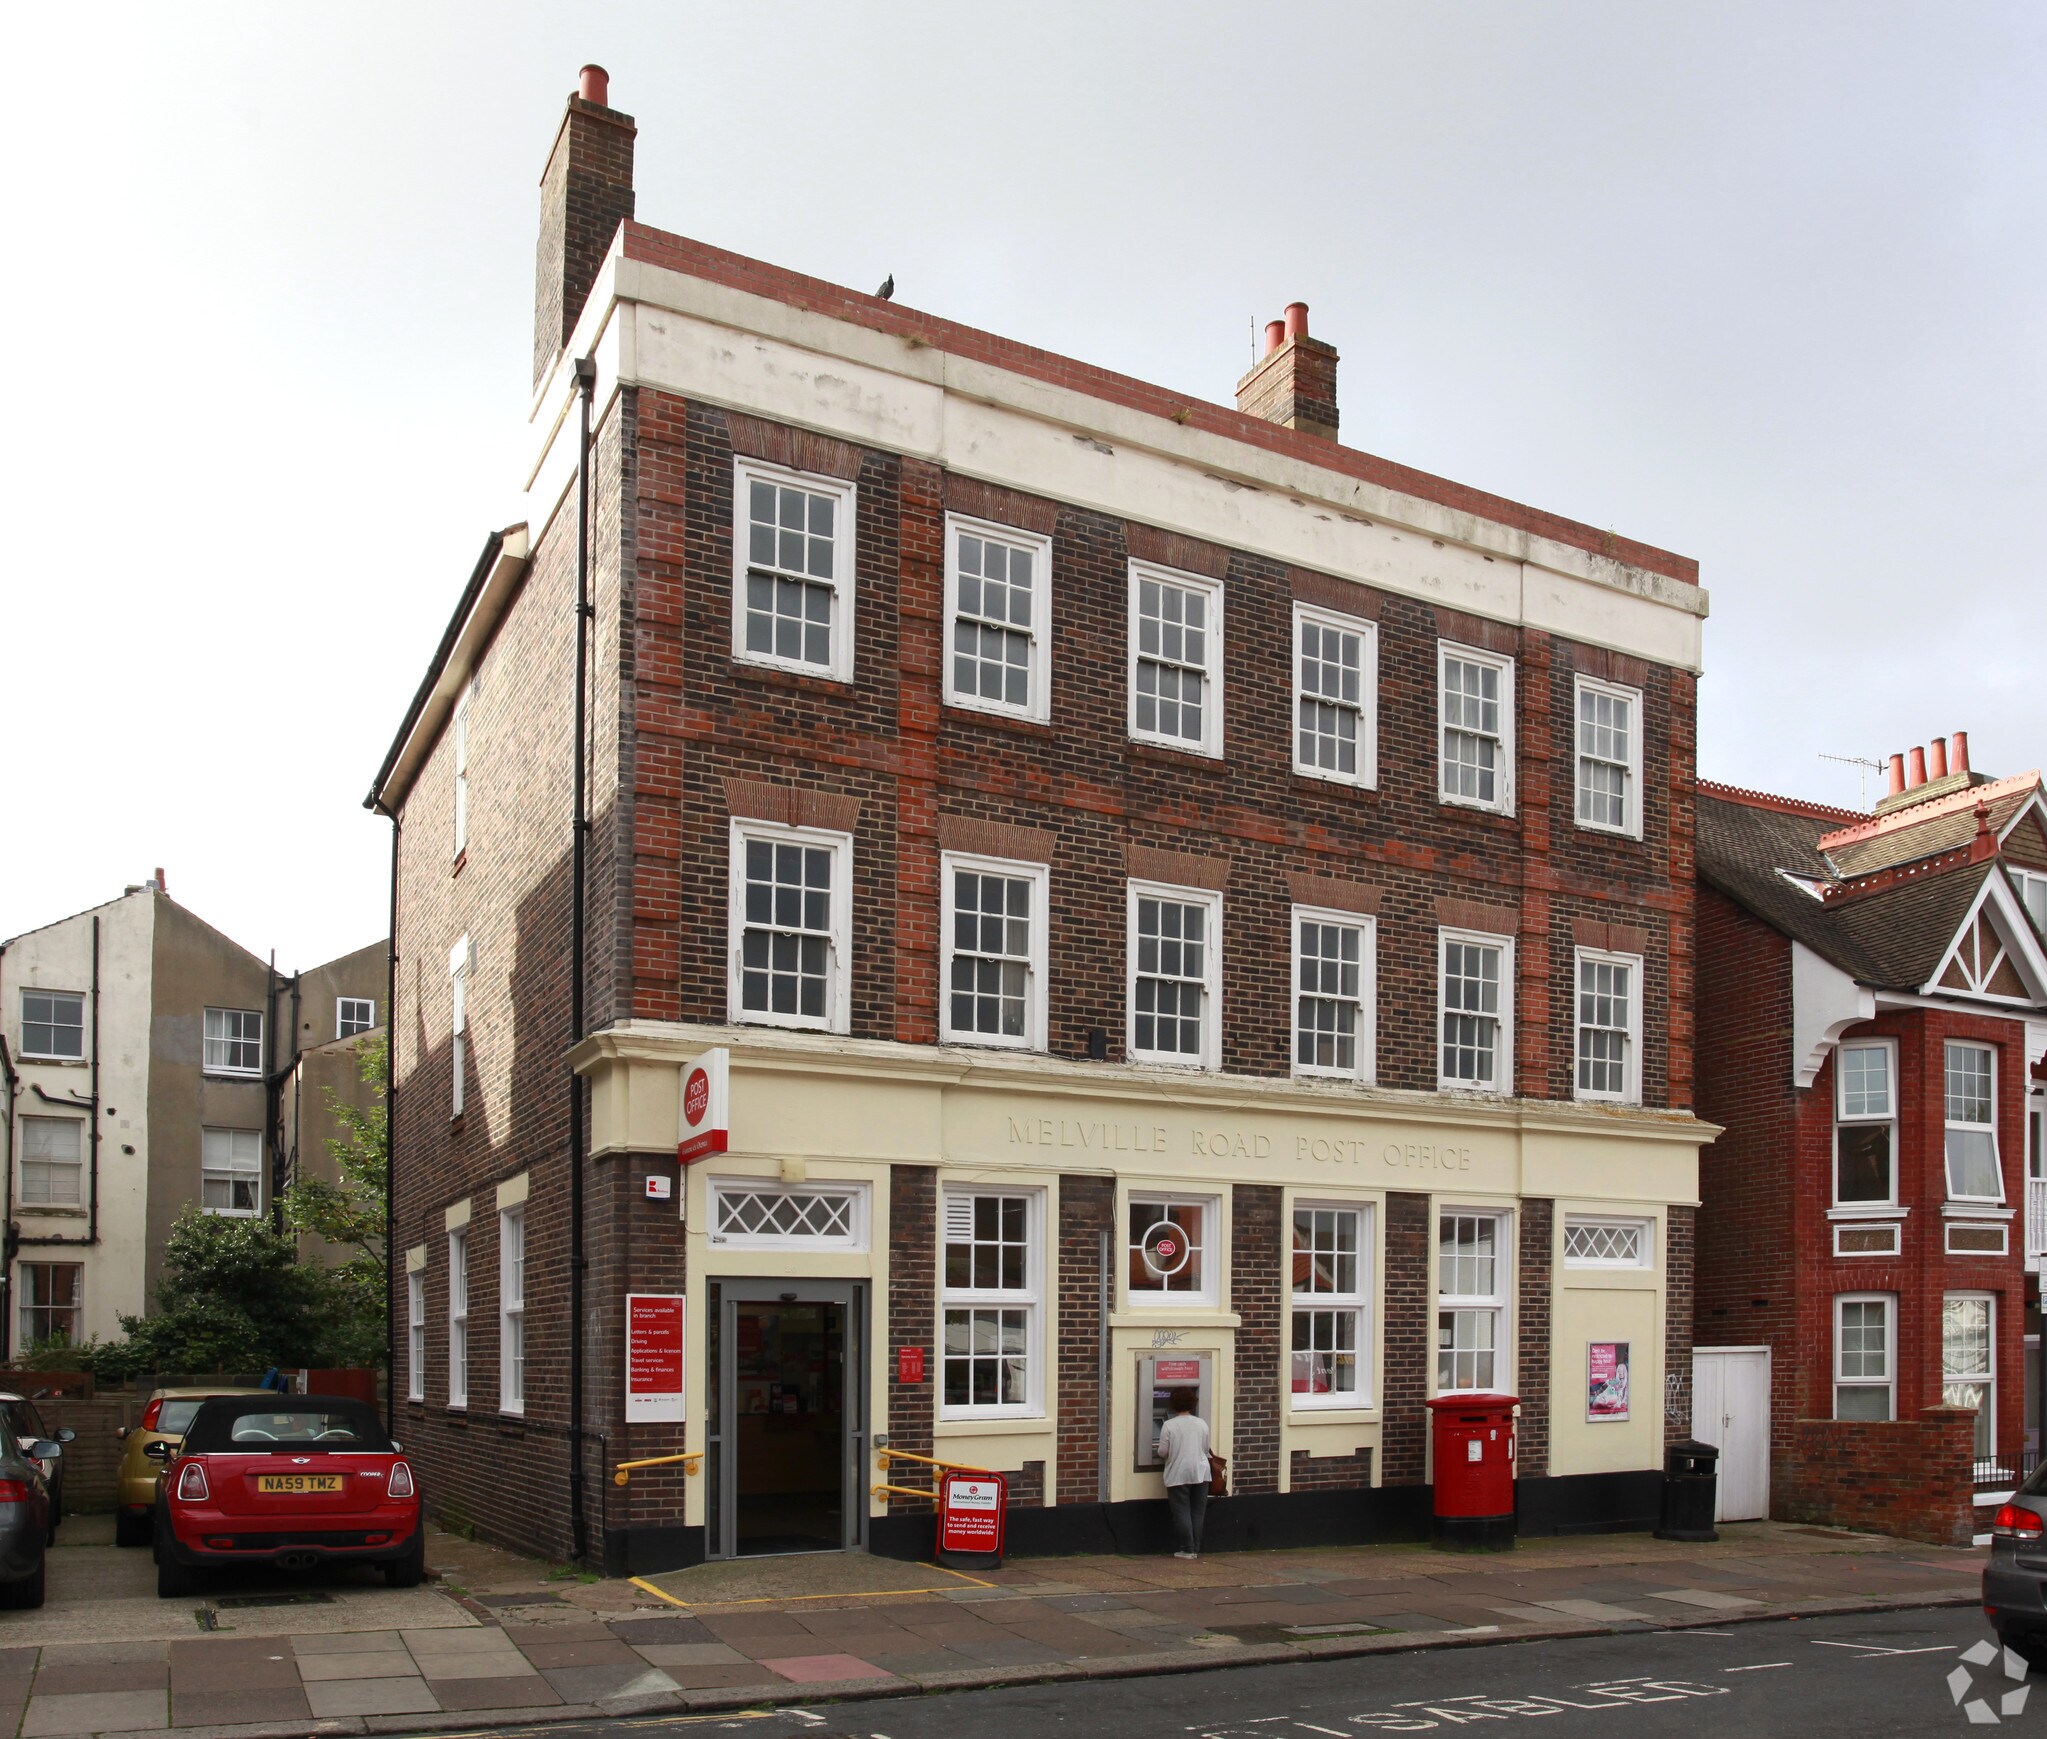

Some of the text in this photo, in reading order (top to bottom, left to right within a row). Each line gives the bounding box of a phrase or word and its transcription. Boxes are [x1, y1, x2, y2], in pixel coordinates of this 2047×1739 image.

[690, 1078, 705, 1097] POST
[686, 1094, 707, 1114] OFFICE
[1008, 1116, 1471, 1171] MELVILLE ROAD POST OFFICE
[265, 1477, 336, 1490] NA59 TMZ
[952, 1494, 992, 1502] MoneyGram
